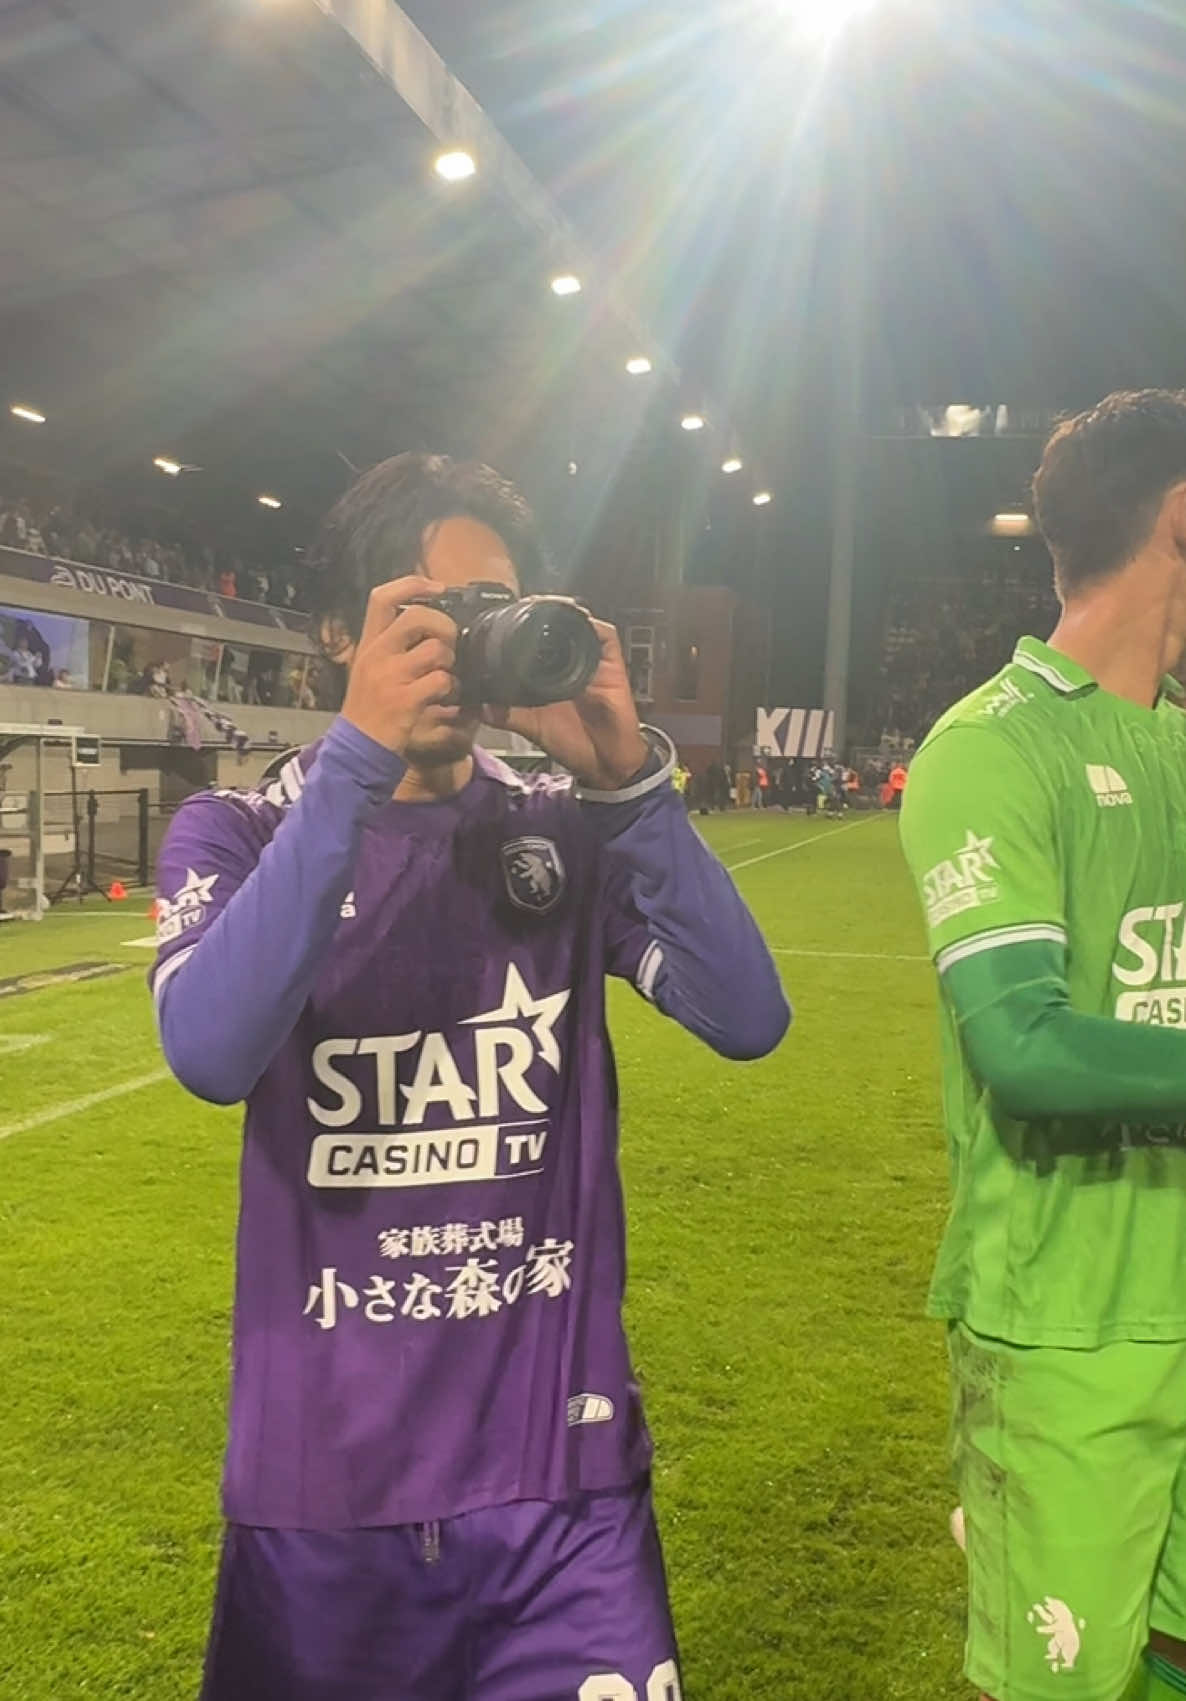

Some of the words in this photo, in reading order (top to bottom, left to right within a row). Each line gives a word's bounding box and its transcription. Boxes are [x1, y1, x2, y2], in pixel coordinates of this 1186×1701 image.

[307, 1026, 549, 1127] STAR
[327, 1138, 479, 1176] CASINO
[505, 1131, 547, 1164] TV
[378, 1216, 524, 1259] 家族葬式場
[302, 1238, 574, 1330] 小さな森の家
